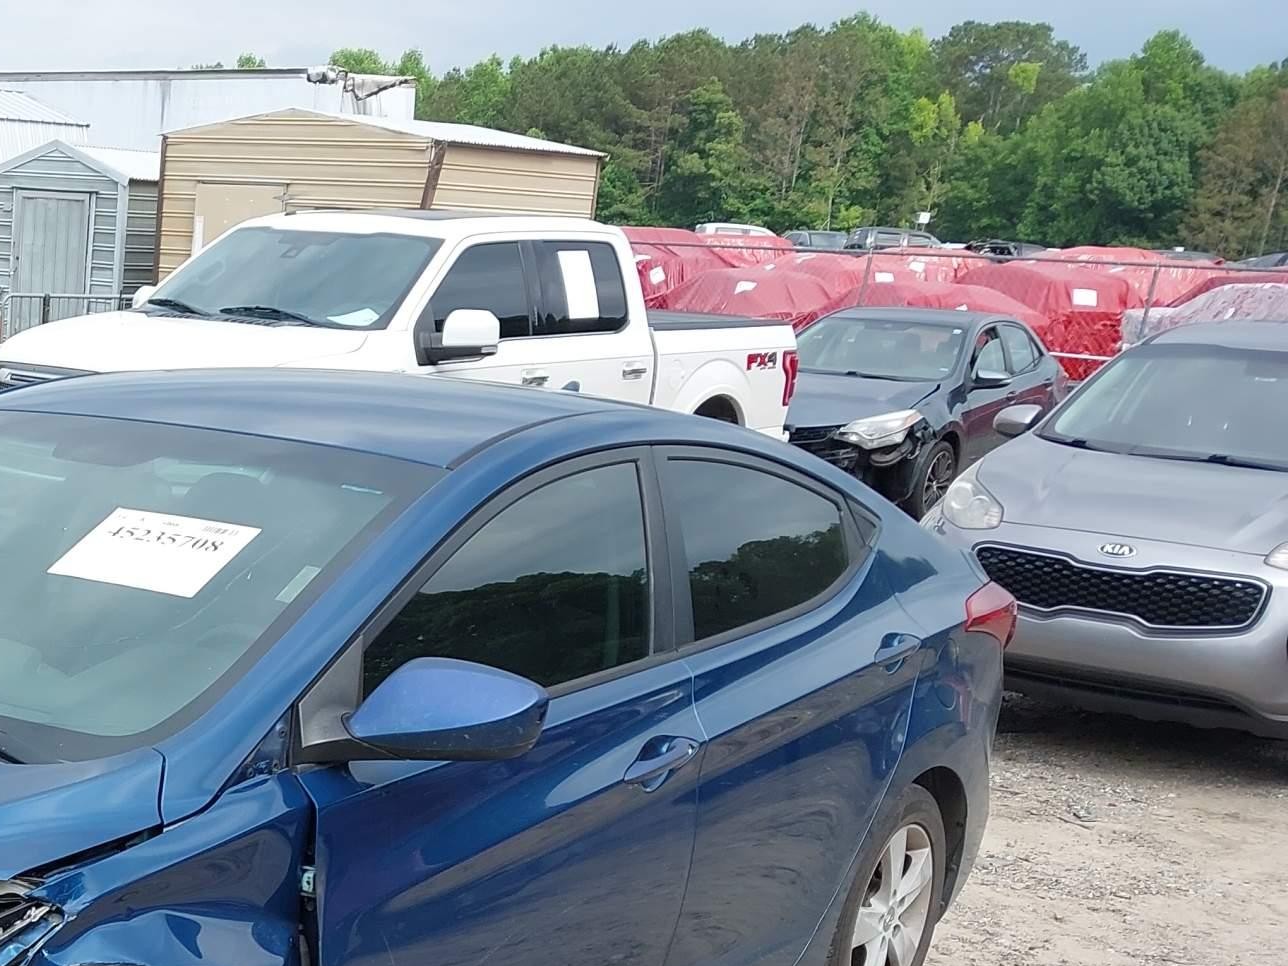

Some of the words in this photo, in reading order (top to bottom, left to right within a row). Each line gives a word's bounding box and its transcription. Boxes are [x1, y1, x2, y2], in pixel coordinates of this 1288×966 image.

[746, 352, 778, 371] FX4
[108, 526, 224, 552] 45235708
[1103, 543, 1131, 555] KIA
